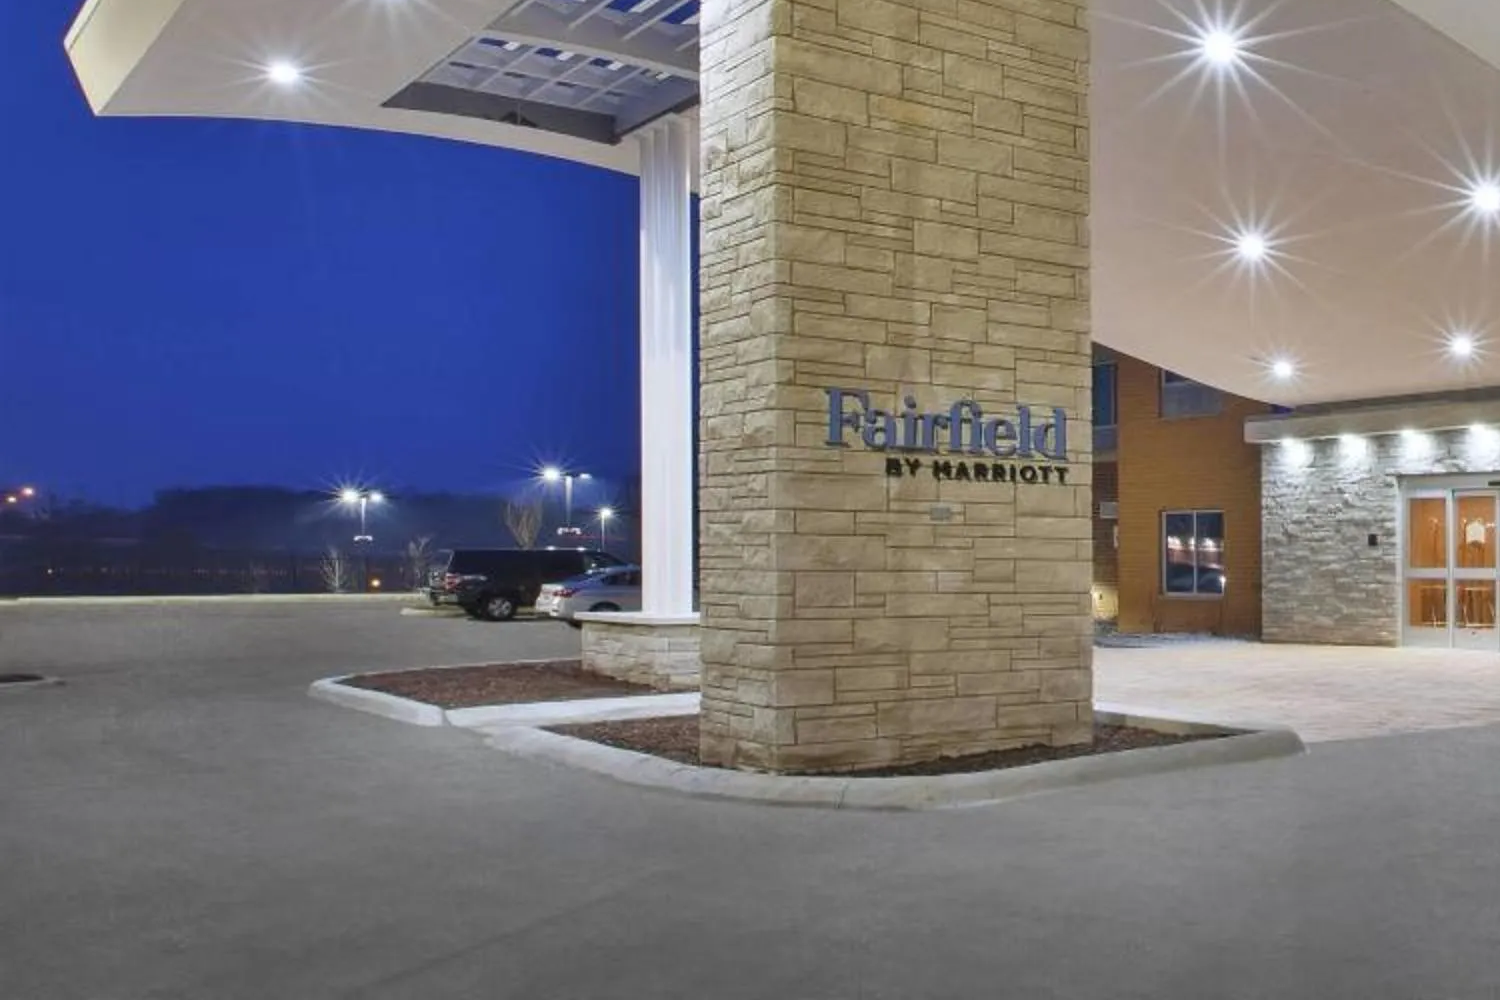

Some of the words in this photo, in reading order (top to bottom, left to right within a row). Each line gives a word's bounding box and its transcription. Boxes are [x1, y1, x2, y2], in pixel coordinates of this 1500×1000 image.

[825, 387, 1068, 461] Fairfield
[886, 457, 922, 477] BY
[932, 460, 1068, 483] MARRIOTT
